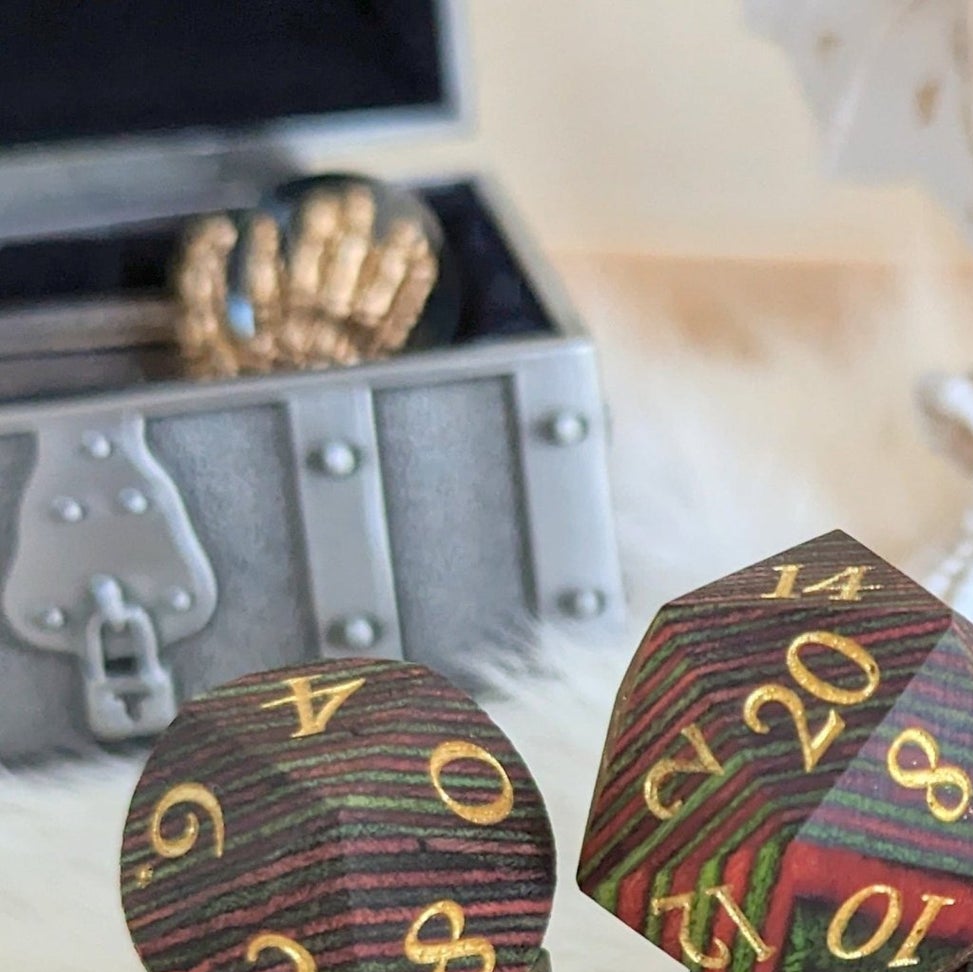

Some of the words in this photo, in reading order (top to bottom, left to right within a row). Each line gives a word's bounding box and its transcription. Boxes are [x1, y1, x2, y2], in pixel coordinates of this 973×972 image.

[761, 564, 884, 601] 14
[261, 675, 366, 738] 4
[743, 630, 881, 773] 20
[429, 740, 513, 825] 0
[643, 724, 724, 821] 2
[887, 726, 973, 823] 8
